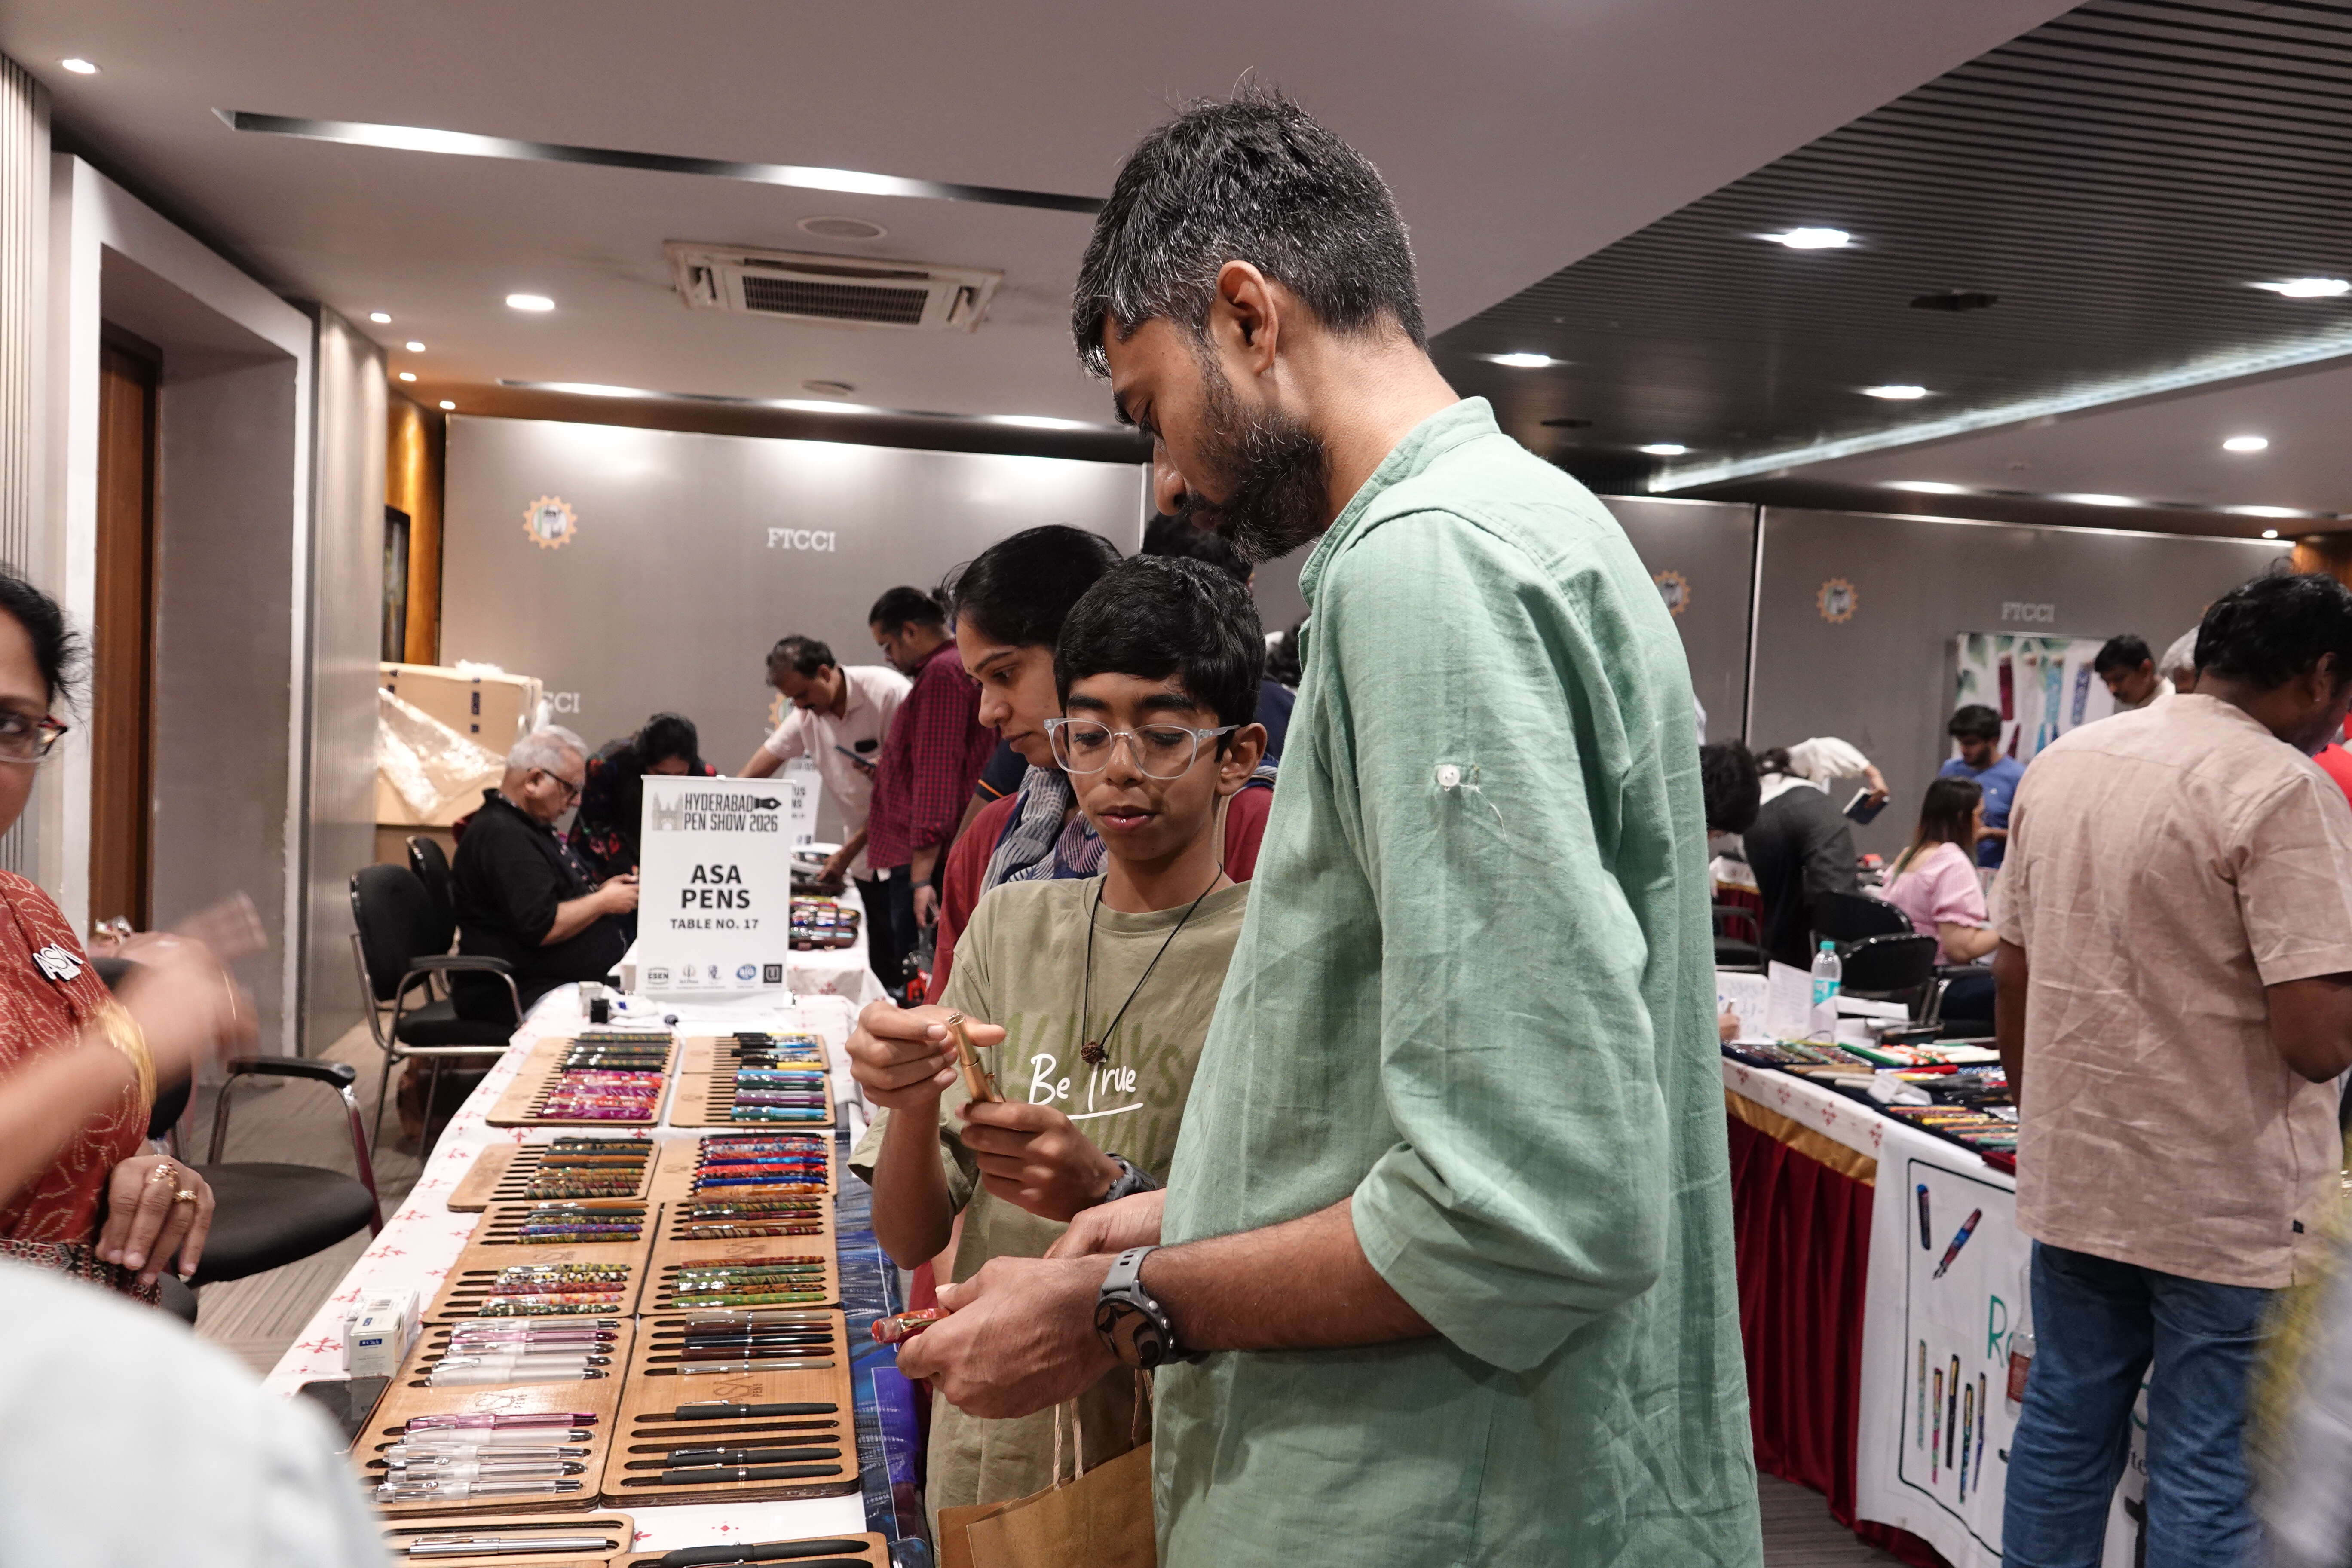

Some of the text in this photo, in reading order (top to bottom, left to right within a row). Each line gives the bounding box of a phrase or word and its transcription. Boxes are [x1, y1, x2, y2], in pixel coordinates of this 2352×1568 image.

[767, 527, 836, 552] FTCCI
[685, 793, 753, 812] HYDERABAD
[684, 813, 778, 832] PEN SHOW 2026
[691, 864, 742, 884] ASA
[681, 889, 750, 909] PENS
[671, 919, 759, 929] TABLE NO. 17
[1029, 1053, 1070, 1105] Be
[1087, 1057, 1136, 1112] True
